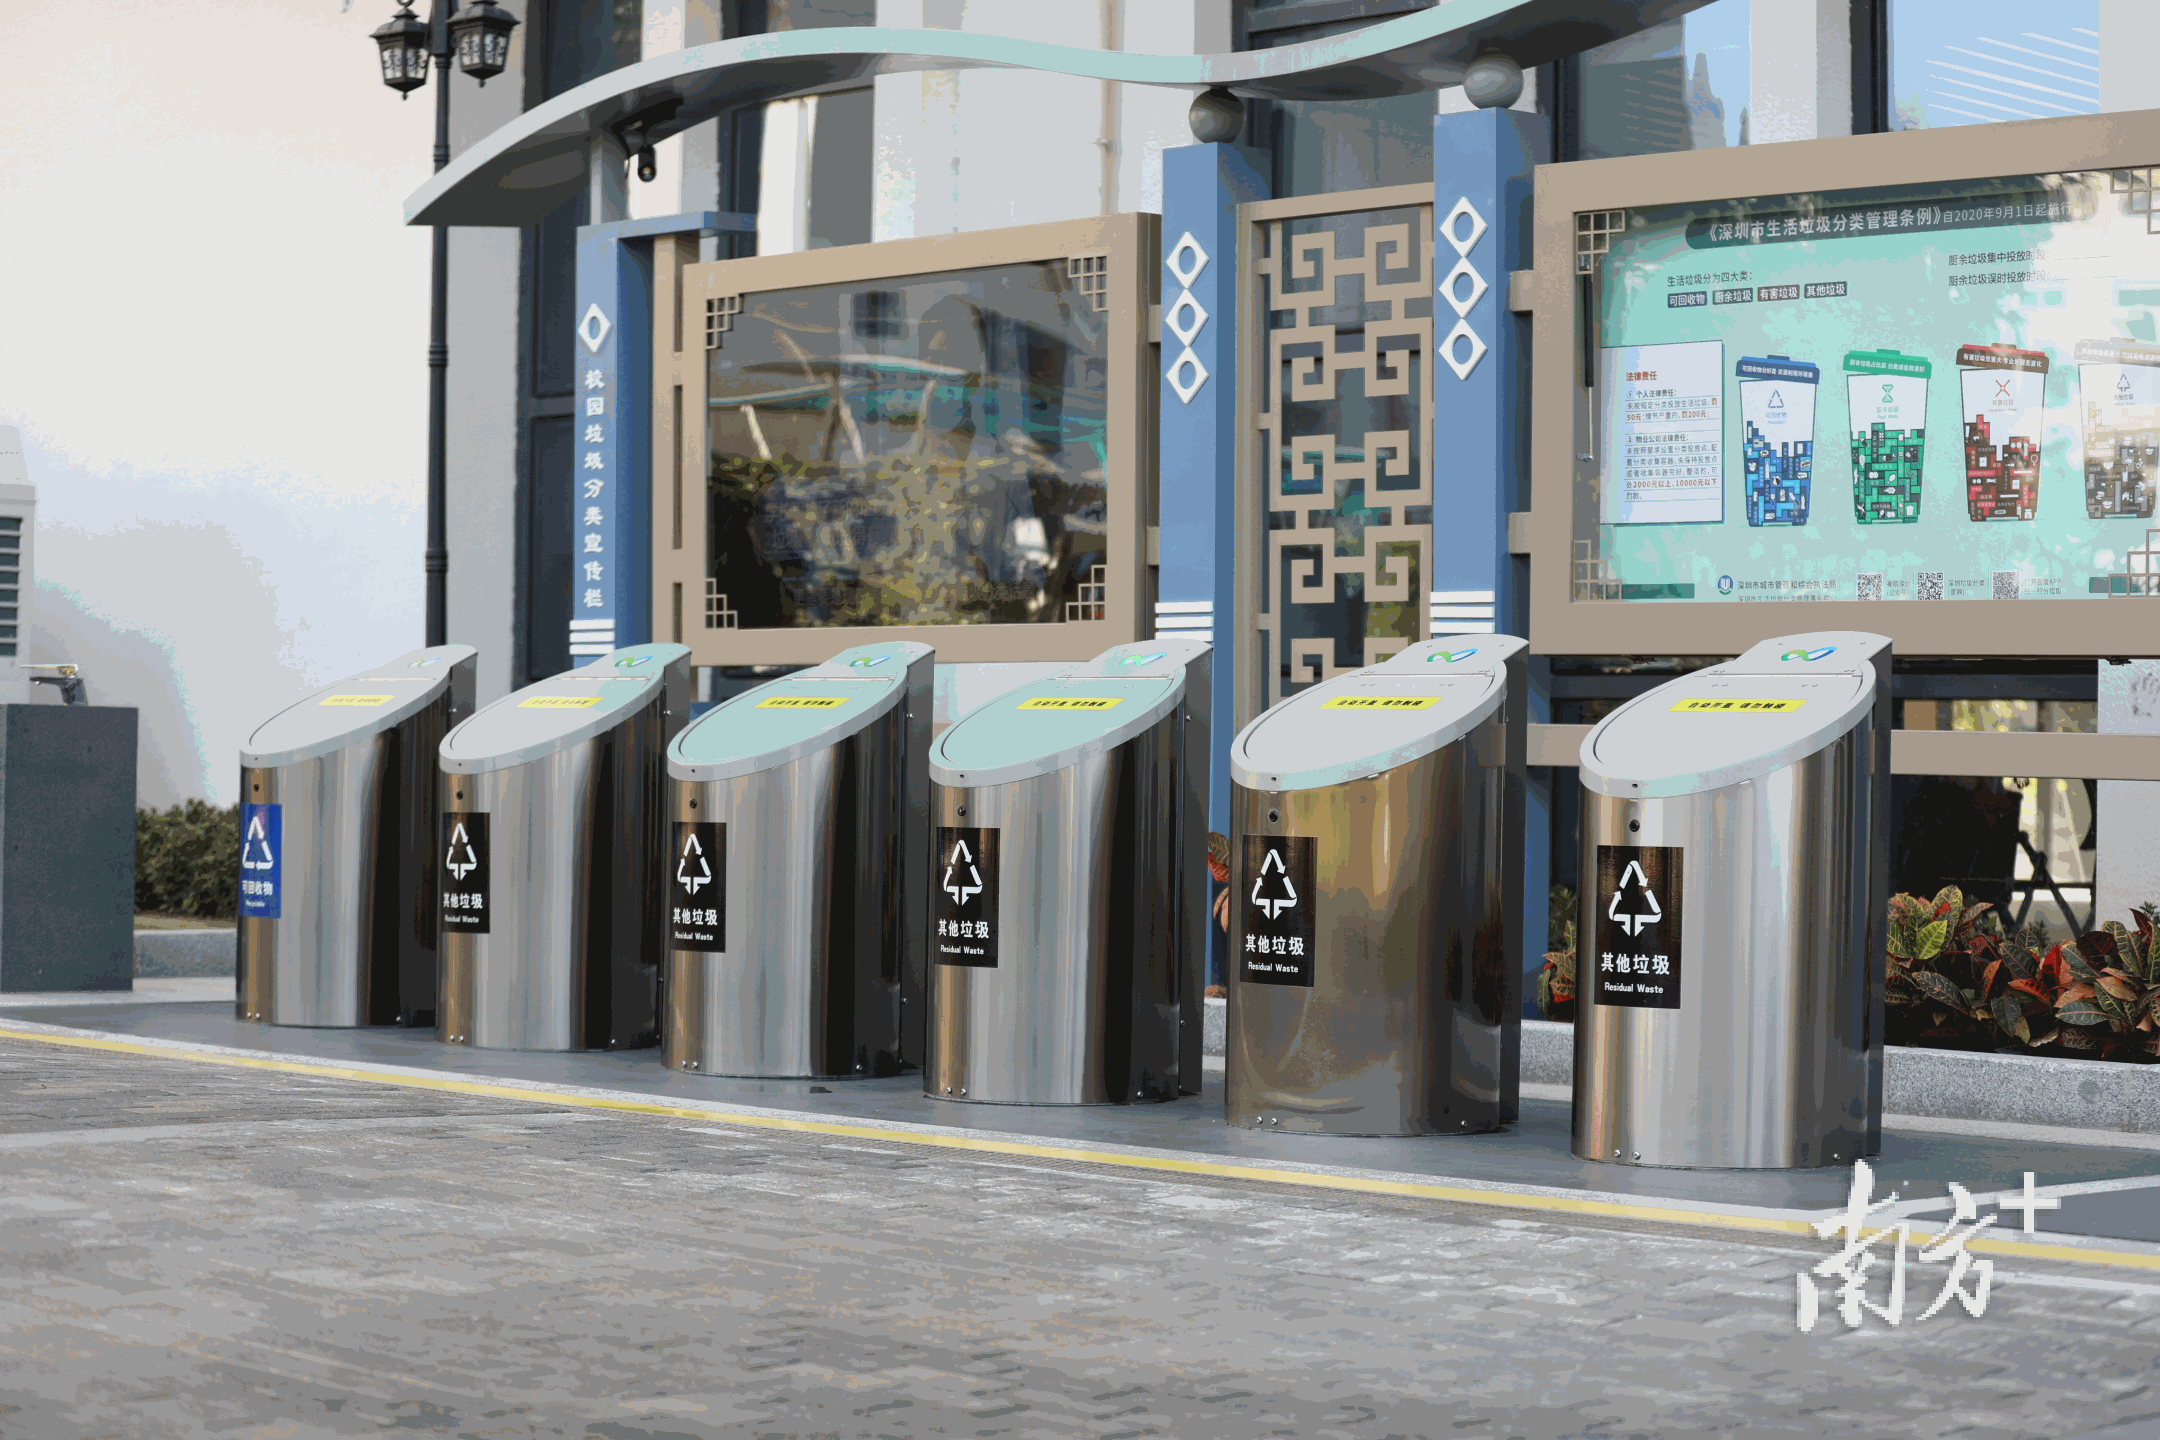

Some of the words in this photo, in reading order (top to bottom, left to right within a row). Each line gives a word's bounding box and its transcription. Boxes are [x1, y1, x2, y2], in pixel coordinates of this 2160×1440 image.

[1709, 206, 1942, 242] 《深圳市生活垃圾分类管理条例》
[1669, 293, 1706, 307] 可回收物
[1714, 290, 1752, 304] 厨余垃圾
[1759, 286, 1798, 300] 有害垃圾
[1806, 282, 1846, 297] 其他垃圾
[1626, 371, 1658, 382] 法律责任
[582, 369, 606, 608] 校园垃圾分类宣传栏
[673, 907, 718, 926] 其他垃圾
[674, 931, 693, 940] Residual
[695, 932, 714, 940] Waste
[938, 918, 989, 938] 其他垃圾
[940, 944, 962, 954] Residual
[964, 946, 984, 954] Waste
[1246, 934, 1304, 956] 其他垃圾
[1248, 962, 1272, 972] Residual
[1275, 964, 1298, 973] Waste
[1601, 952, 1670, 975] 其他垃圾
[1604, 982, 1634, 992] Residual
[1636, 983, 1664, 994] Waste
